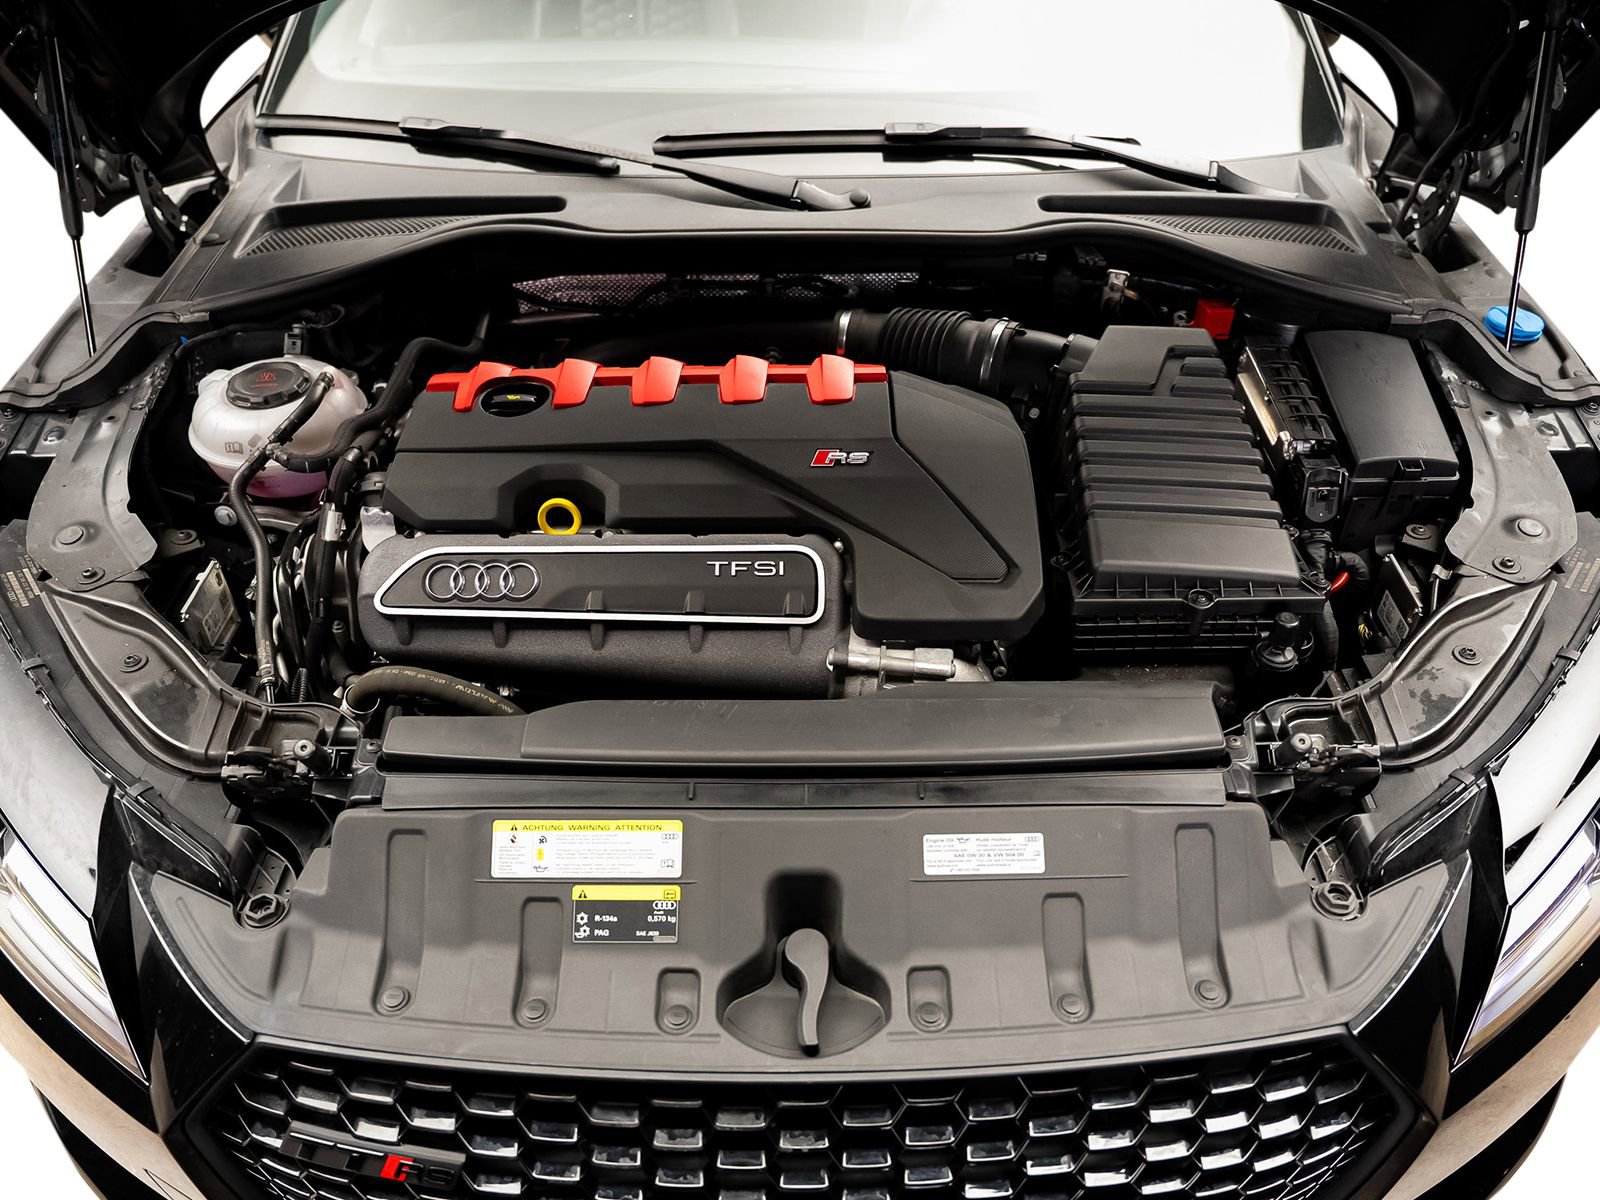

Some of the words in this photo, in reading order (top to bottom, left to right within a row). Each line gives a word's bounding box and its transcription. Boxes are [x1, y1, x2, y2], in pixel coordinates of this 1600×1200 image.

[811, 449, 870, 466] RS
[707, 561, 784, 576] TFSI
[668, 915, 676, 923] kg
